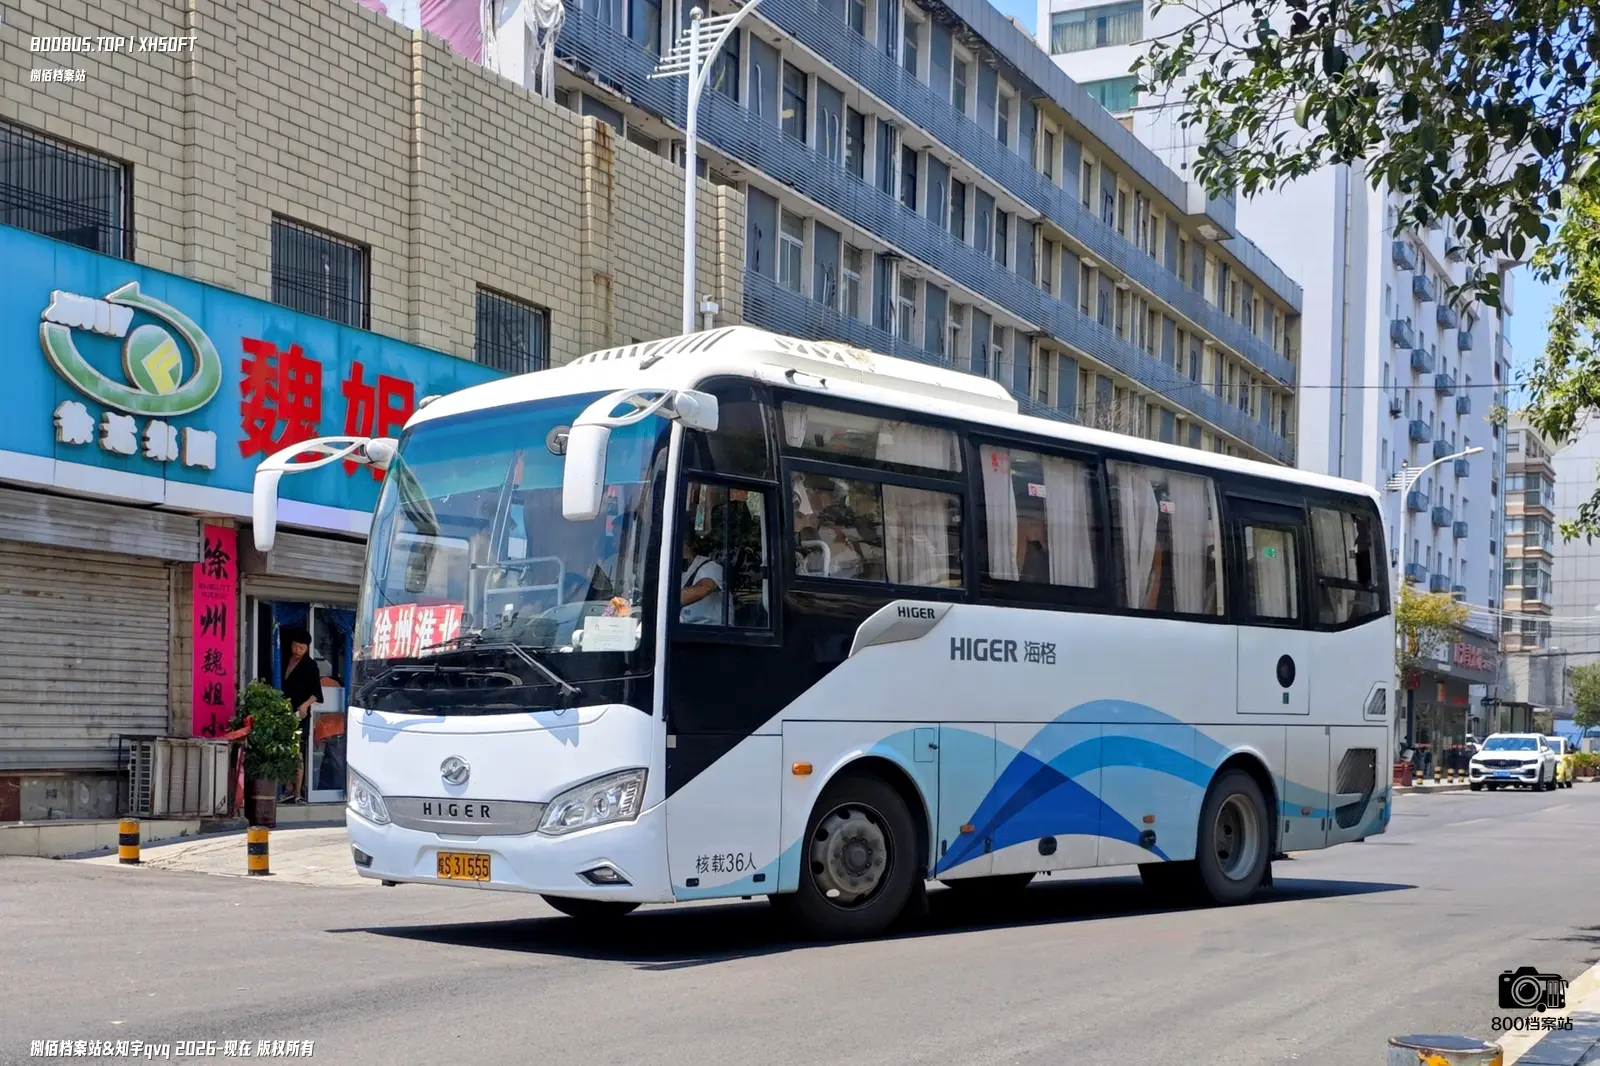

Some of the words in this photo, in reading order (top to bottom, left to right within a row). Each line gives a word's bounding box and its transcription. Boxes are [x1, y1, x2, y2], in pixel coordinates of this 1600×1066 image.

[897, 606, 936, 620] HIGER
[371, 606, 460, 660] 徐州淮北
[950, 636, 1018, 663] HIGER
[1023, 640, 1057, 665] 海格
[423, 802, 491, 819] HIGER
[695, 851, 757, 875] 核载36人
